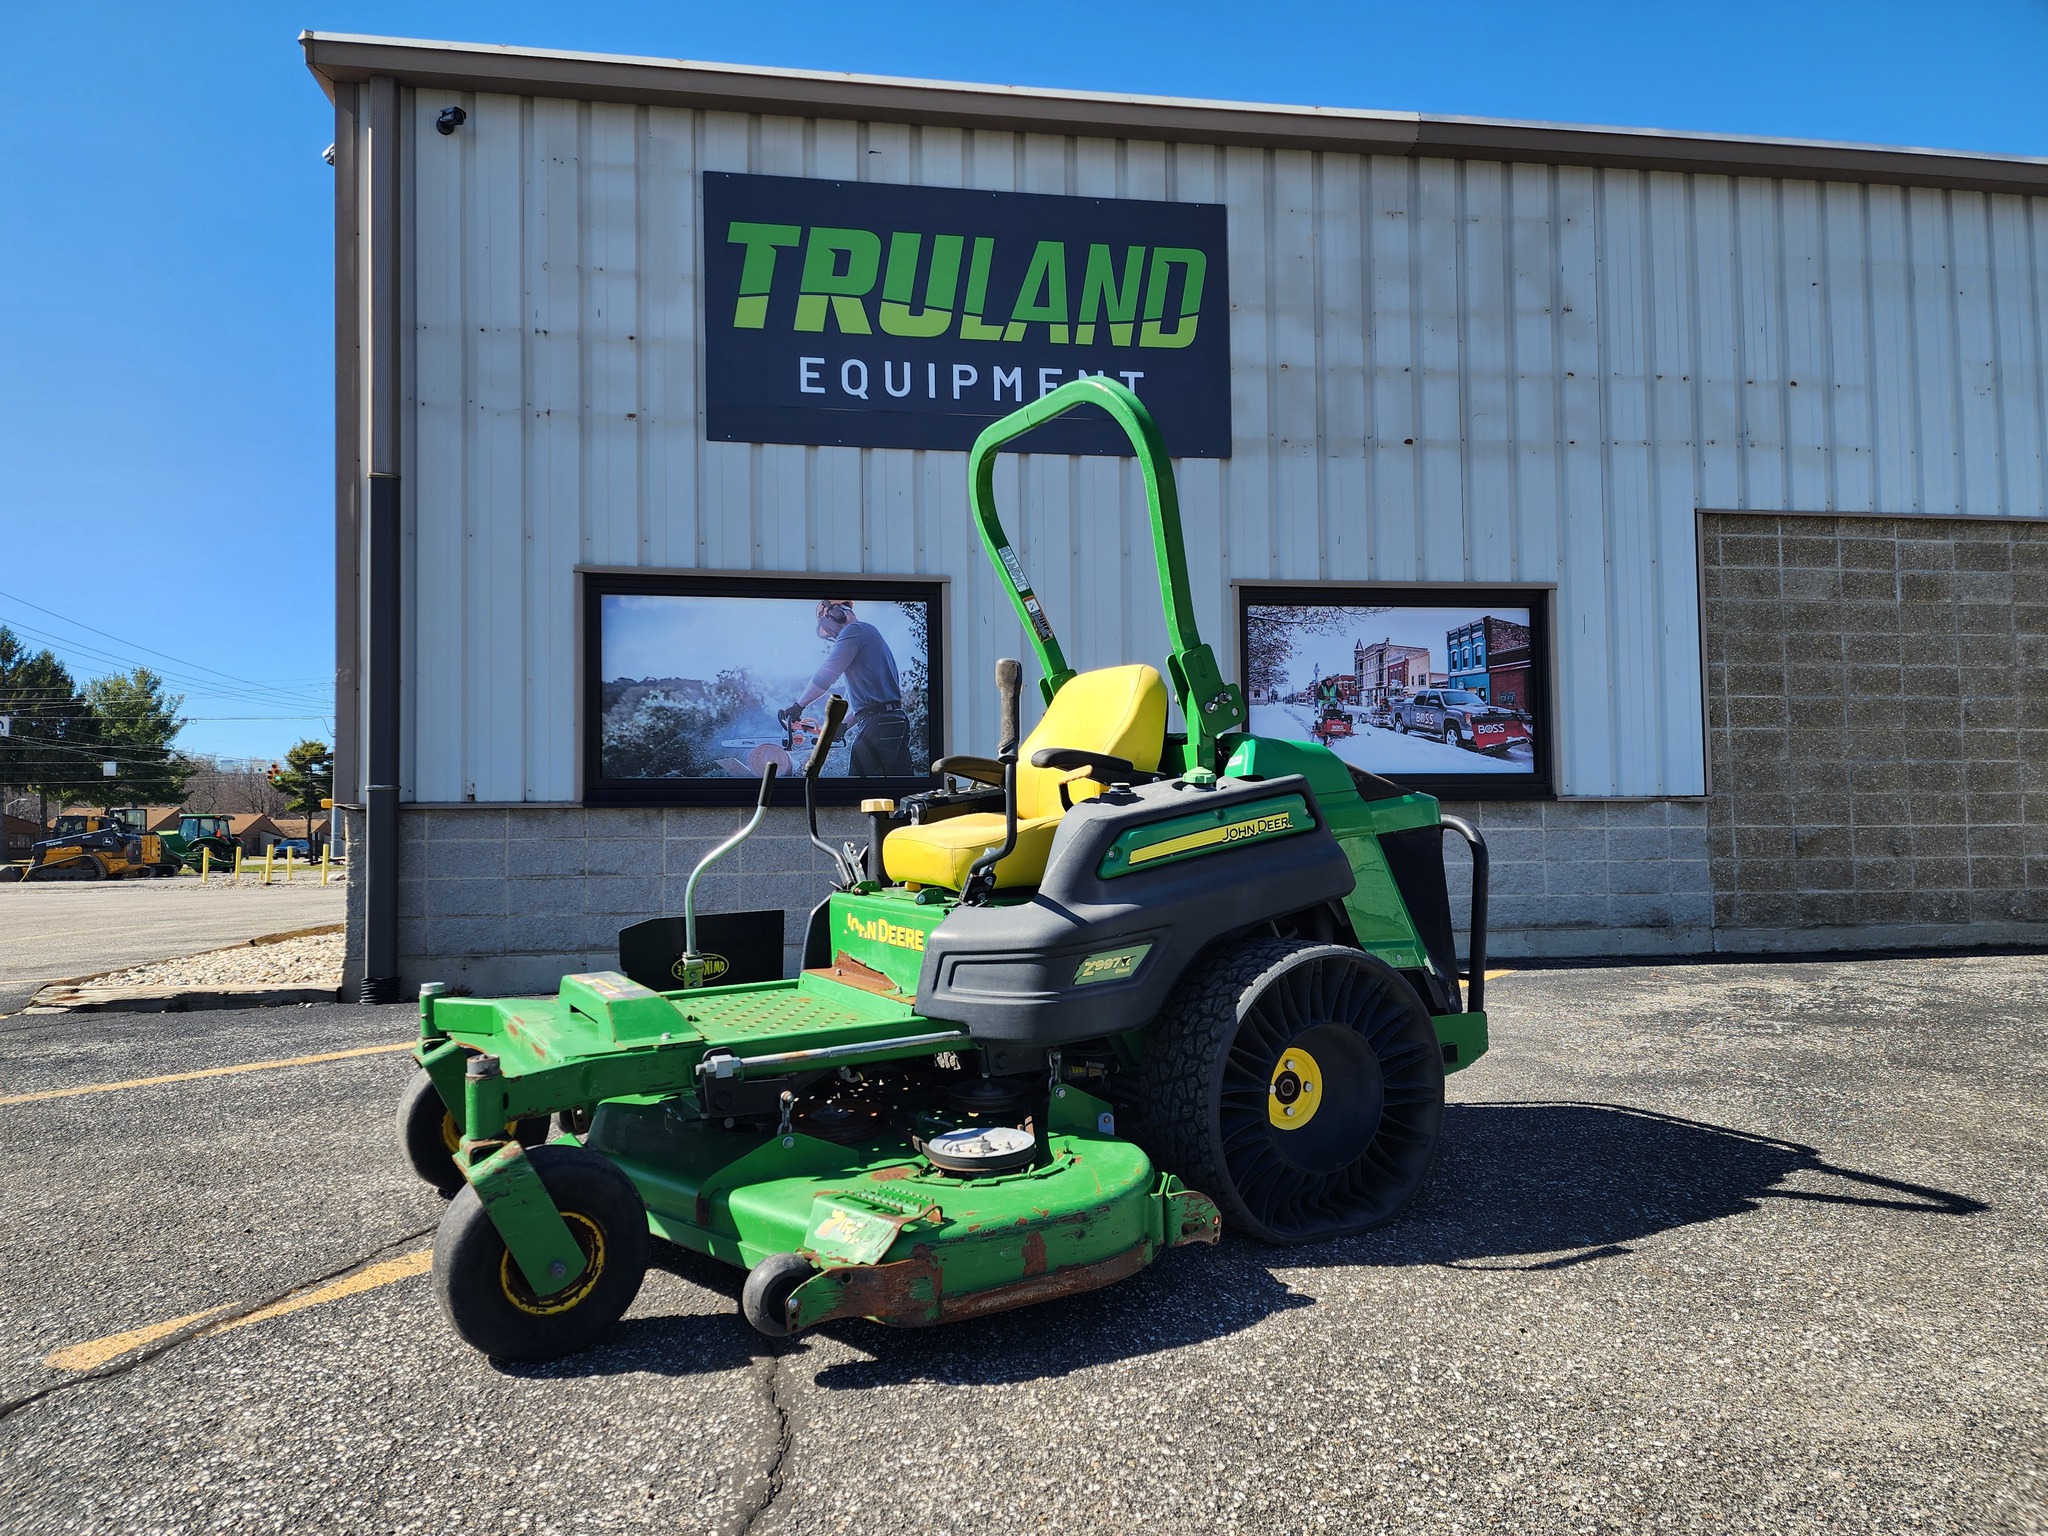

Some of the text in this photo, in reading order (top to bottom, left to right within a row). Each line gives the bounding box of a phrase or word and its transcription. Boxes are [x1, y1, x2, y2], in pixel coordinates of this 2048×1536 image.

[727, 221, 1207, 349] TRULAND
[1415, 712, 1434, 725] BOSS
[1478, 723, 1505, 734] BOSS
[1222, 825, 1256, 842] JOHN
[878, 917, 924, 952] DEERE
